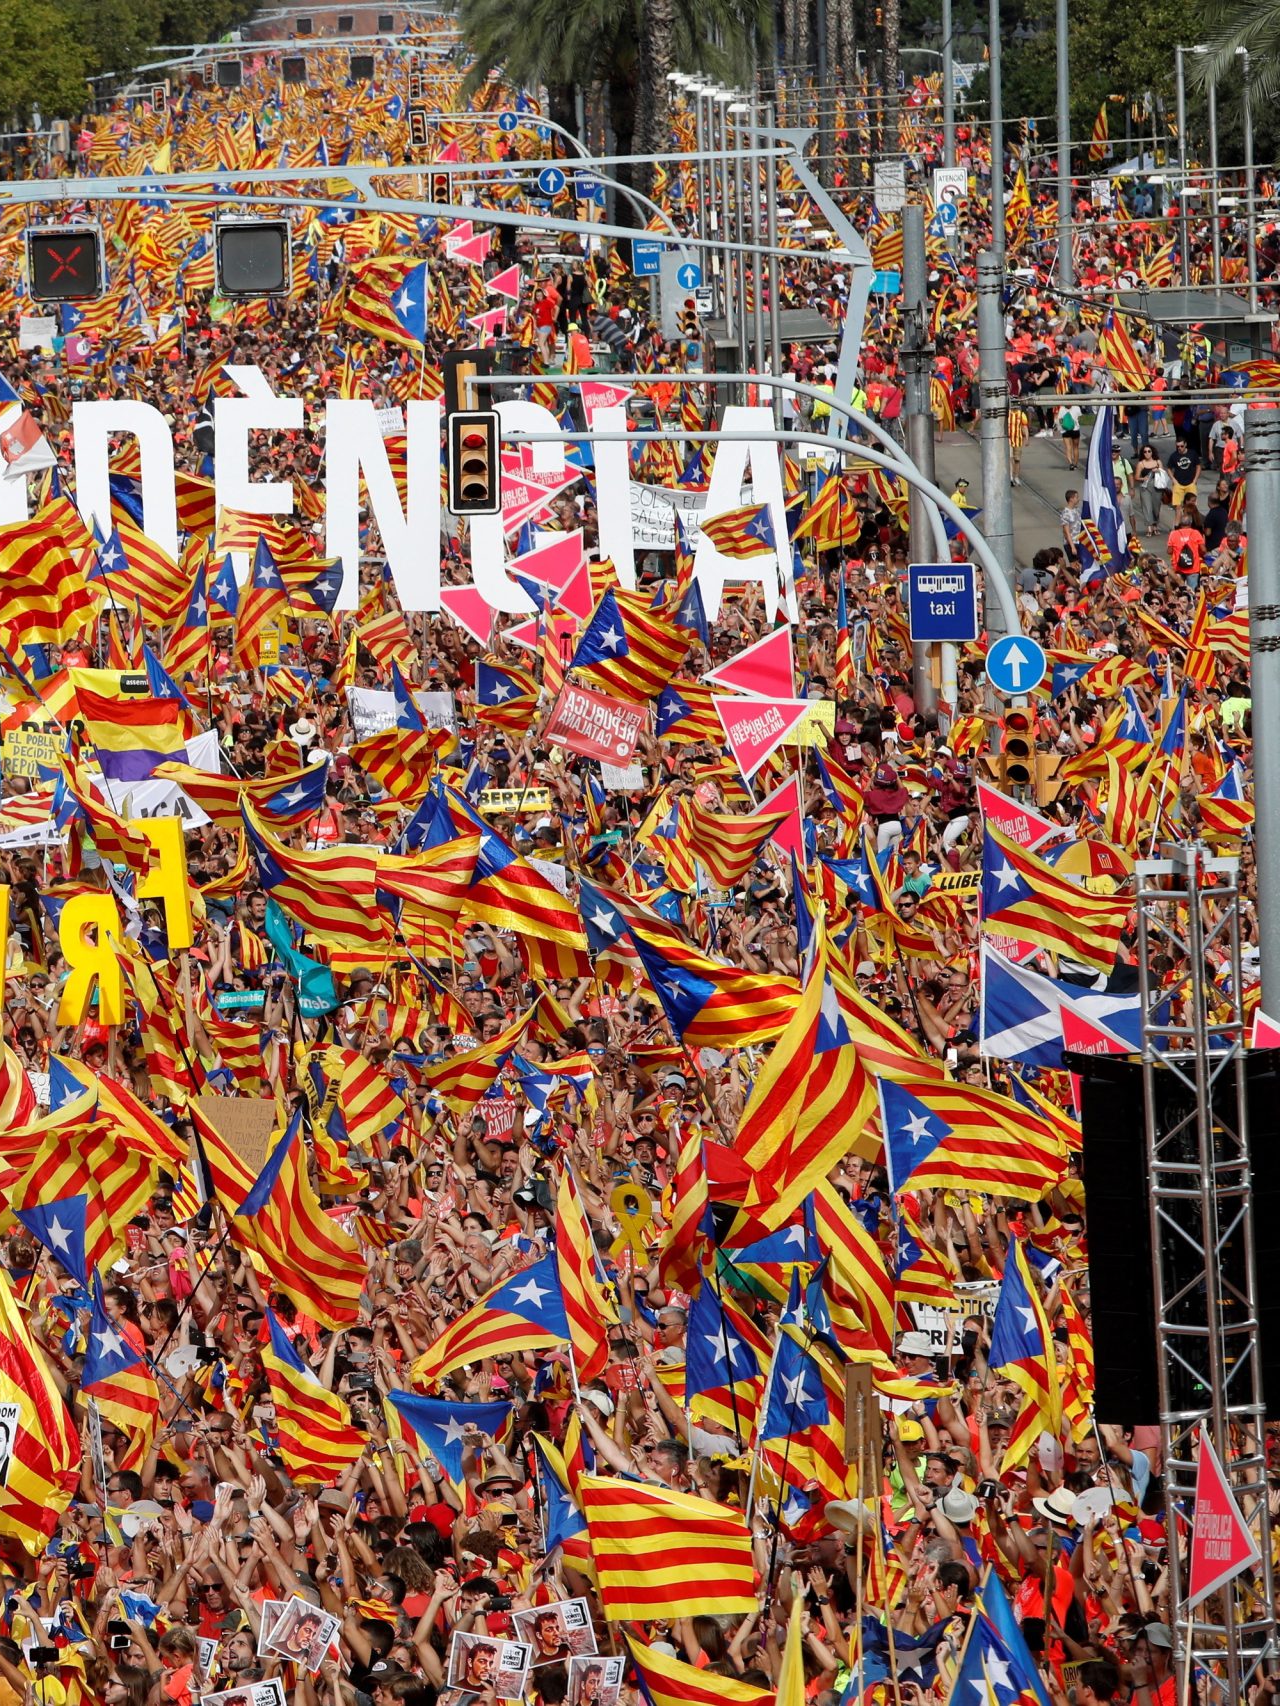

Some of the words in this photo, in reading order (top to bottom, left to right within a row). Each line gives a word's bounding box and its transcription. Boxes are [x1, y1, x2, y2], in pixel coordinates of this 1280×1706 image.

[643, 262, 658, 270] taxi
[930, 601, 956, 615] taxi
[733, 706, 781, 746] REPÚBLICA
[751, 715, 786, 747] CATALANA
[8, 733, 21, 744] EL
[26, 733, 55, 746] POBLE
[478, 789, 549, 806] BERTAT
